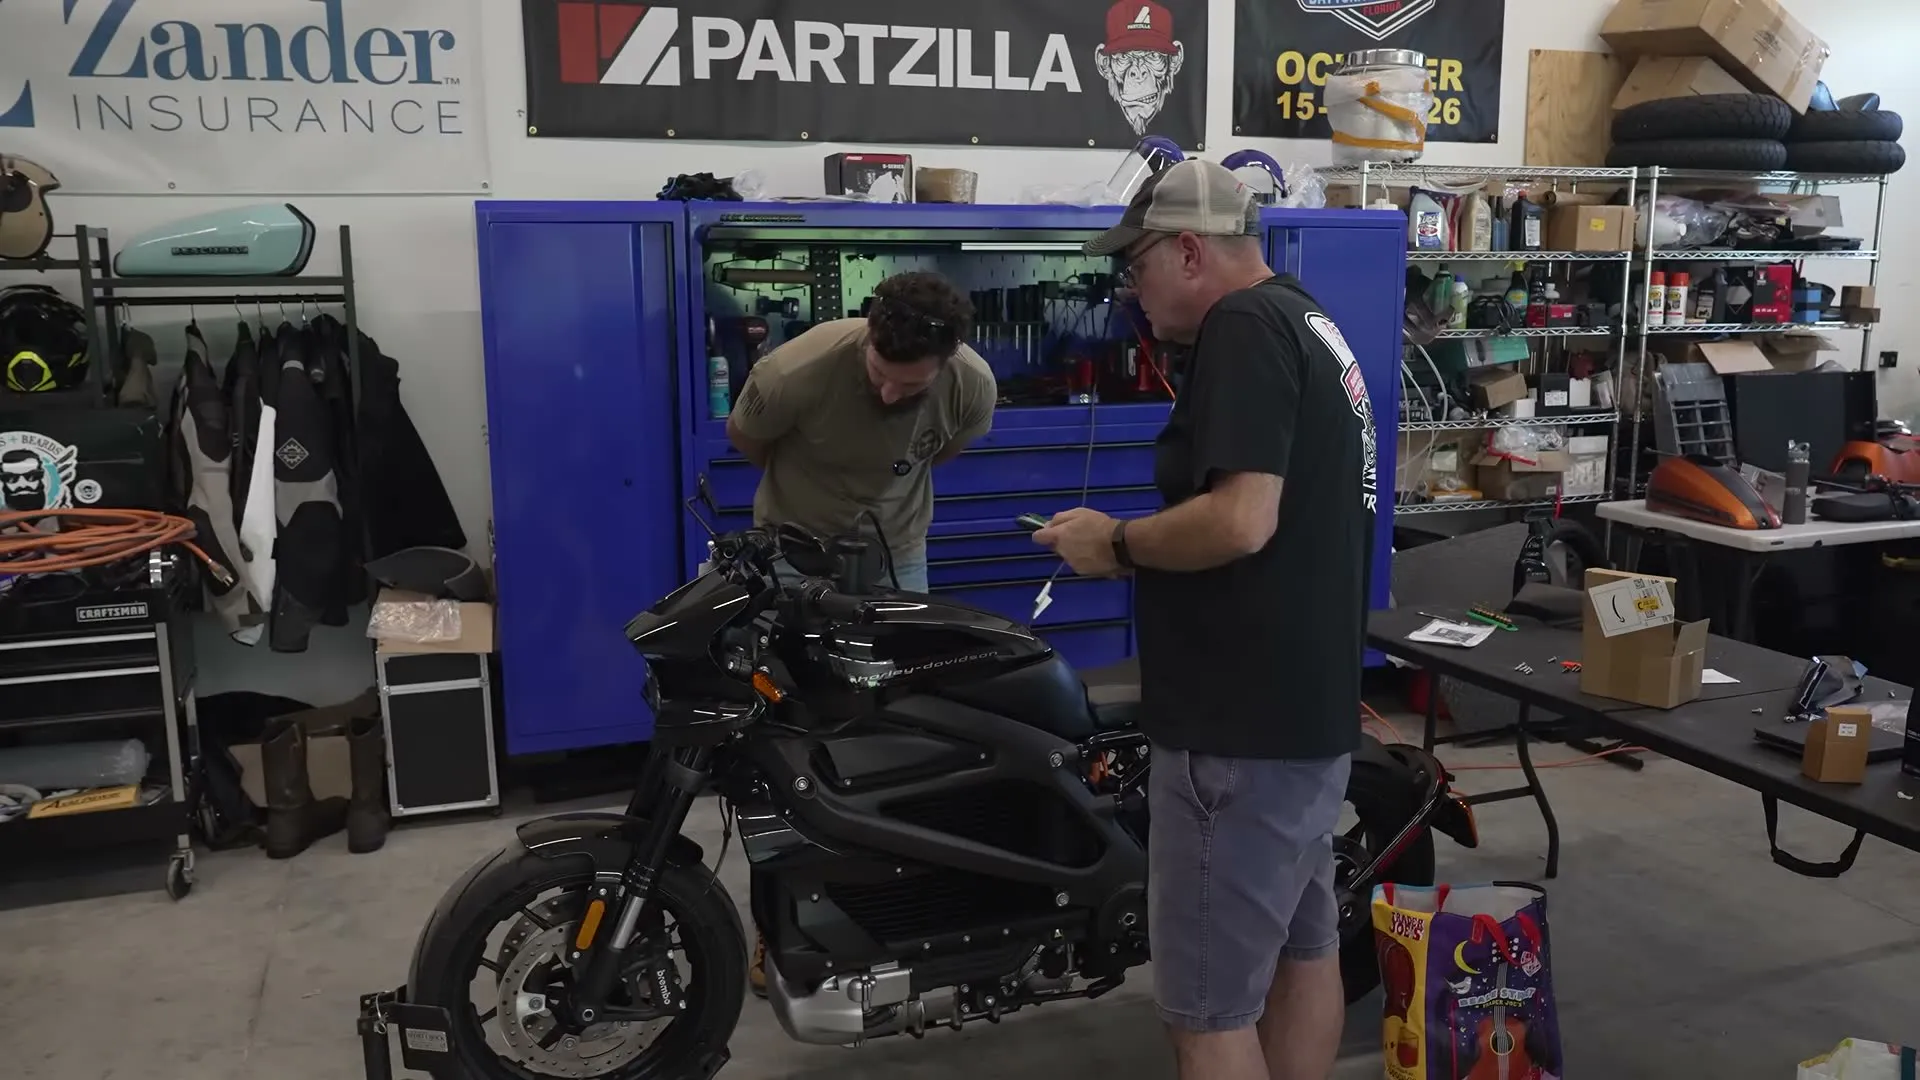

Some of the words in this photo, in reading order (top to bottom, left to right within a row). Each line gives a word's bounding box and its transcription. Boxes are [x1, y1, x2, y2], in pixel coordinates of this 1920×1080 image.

[1363, 1, 1402, 16] FLORIDA
[62, 0, 456, 86] Zander
[692, 16, 1082, 93] PARTZILLA
[72, 93, 463, 135] INSURANCE
[21, 434, 64, 455] BEARDS
[79, 603, 146, 619] CRAFTSMAN
[656, 969, 671, 1005] brembo
